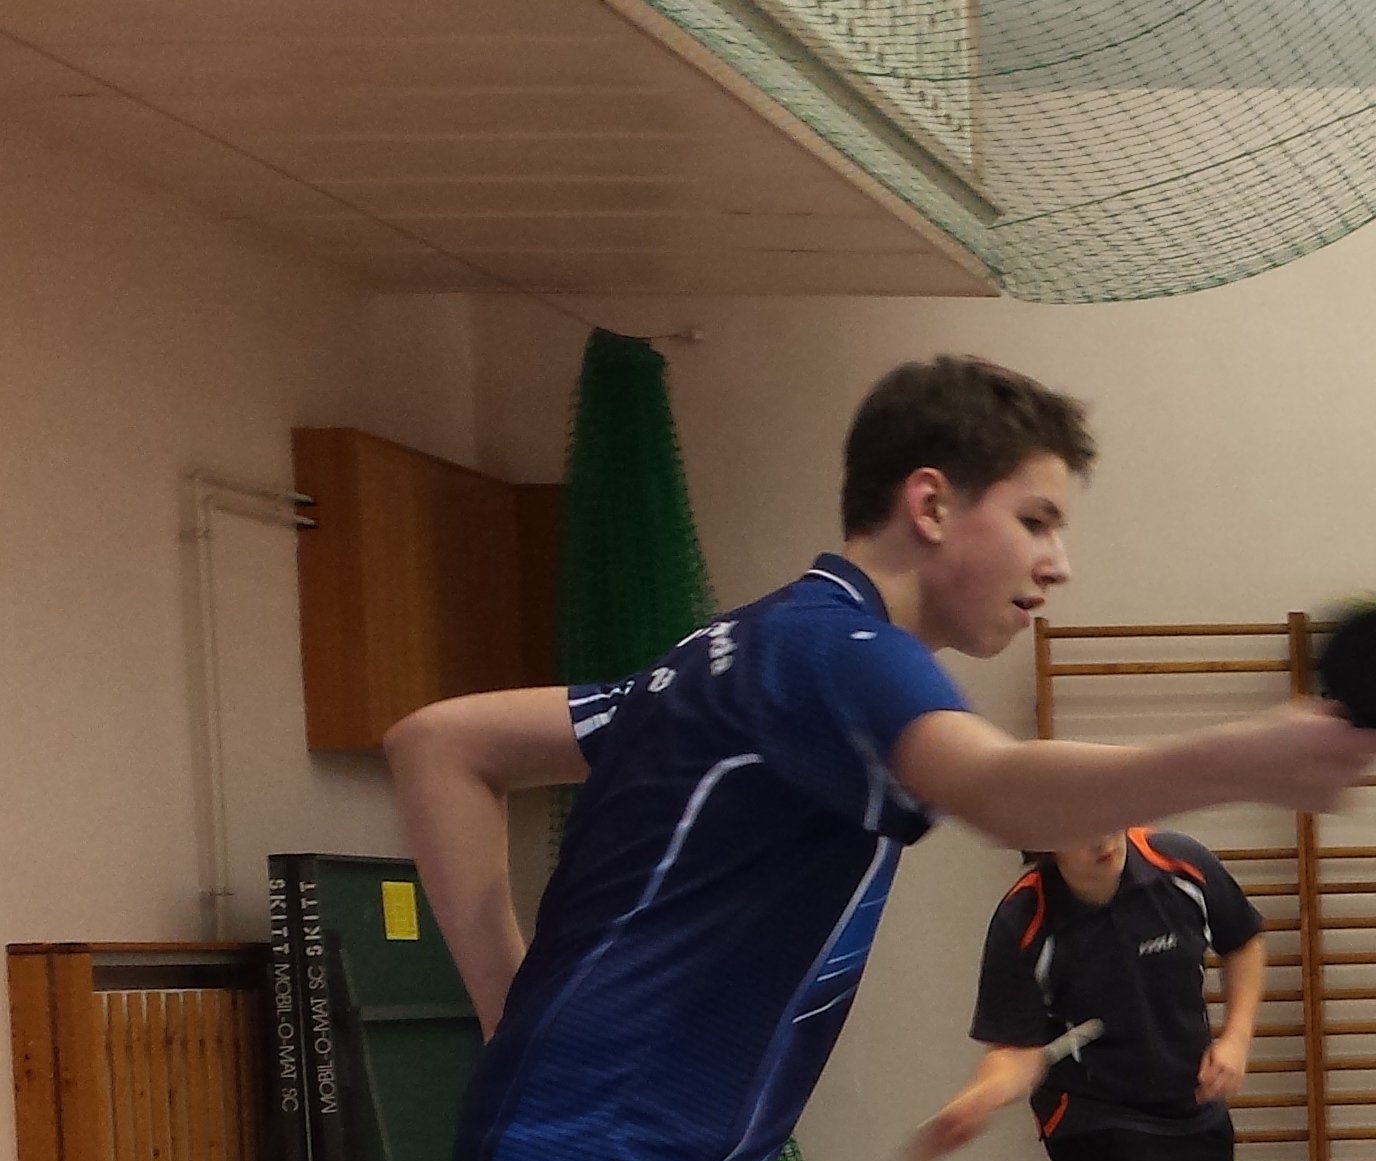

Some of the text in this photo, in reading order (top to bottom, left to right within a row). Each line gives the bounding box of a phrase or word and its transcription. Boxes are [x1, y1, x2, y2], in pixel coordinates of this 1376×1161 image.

[307, 965, 326, 990] SC
[274, 963, 297, 1080] MOBIL-O-MAT
[310, 996, 337, 1113] MOBIL-O-MAT
[281, 1088, 299, 1113] SC
